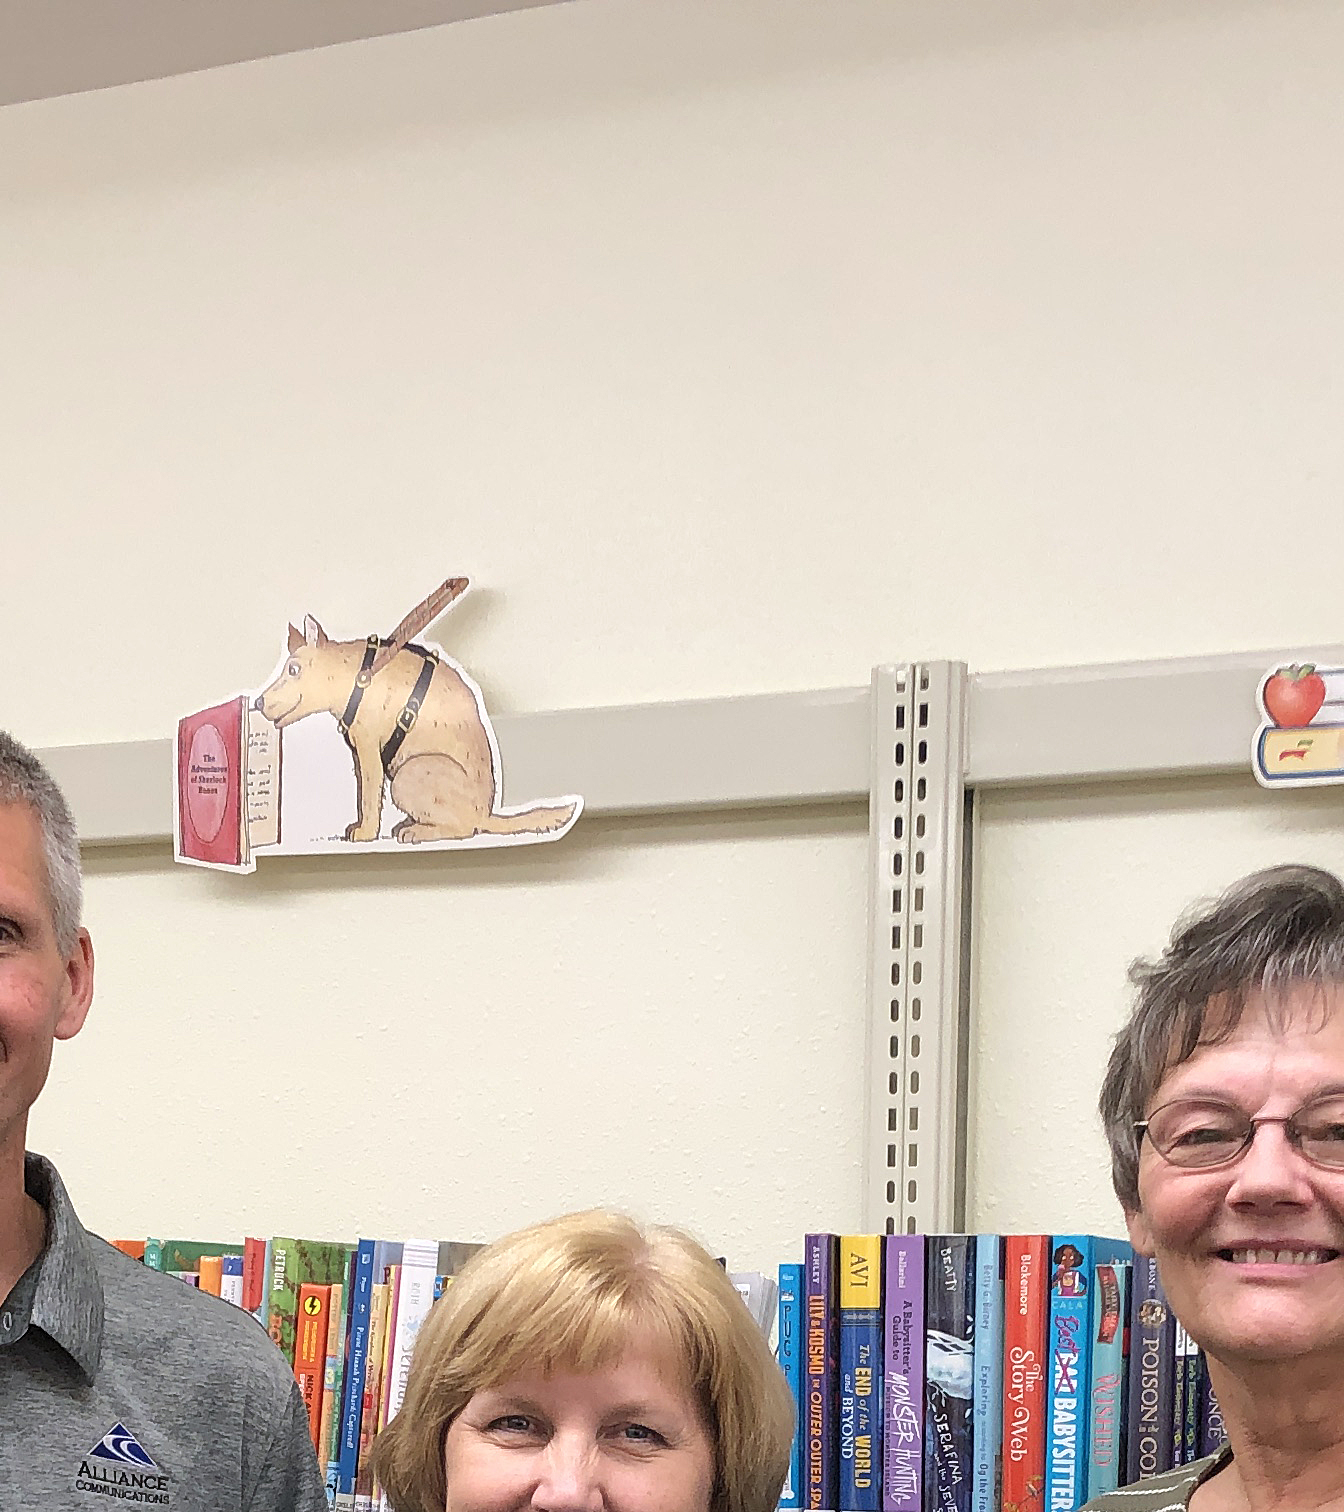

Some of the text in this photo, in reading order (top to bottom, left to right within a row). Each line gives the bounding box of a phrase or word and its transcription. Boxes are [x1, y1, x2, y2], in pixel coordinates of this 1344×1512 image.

[273, 1249, 286, 1291] PETRUCK
[812, 1246, 820, 1284] ASHLEY
[850, 1252, 869, 1288] AVI
[898, 1251, 907, 1288] Ballarini
[940, 1247, 957, 1292] BEATTY
[1019, 1254, 1031, 1315] Blakemore
[809, 1295, 825, 1319] LILY
[783, 1305, 792, 1357] PUG
[809, 1328, 825, 1375] KOSMO
[891, 1316, 901, 1361] Guide to
[901, 1301, 912, 1374] A Babysitter's
[1055, 1315, 1081, 1356] Best
[305, 1374, 314, 1399] NICK
[977, 1365, 990, 1417] Exploring
[1025, 1364, 1043, 1392] The
[1141, 1338, 1160, 1422] POISON
[810, 1392, 822, 1436] OUTER
[842, 1374, 854, 1459] and BEYOND
[854, 1345, 872, 1488] The END of the WORLD
[1007, 1346, 1035, 1461] Story Web
[810, 1439, 821, 1483] OUTER
[885, 1372, 921, 1506] MONSTER HUNTING
[933, 1413, 962, 1486] SERAFINA
[76, 1480, 169, 1504] COMMUNICATIONS
[77, 1461, 169, 1491] ALLIANCE
[979, 1478, 988, 1494] the
[810, 1488, 821, 1510] SPA
